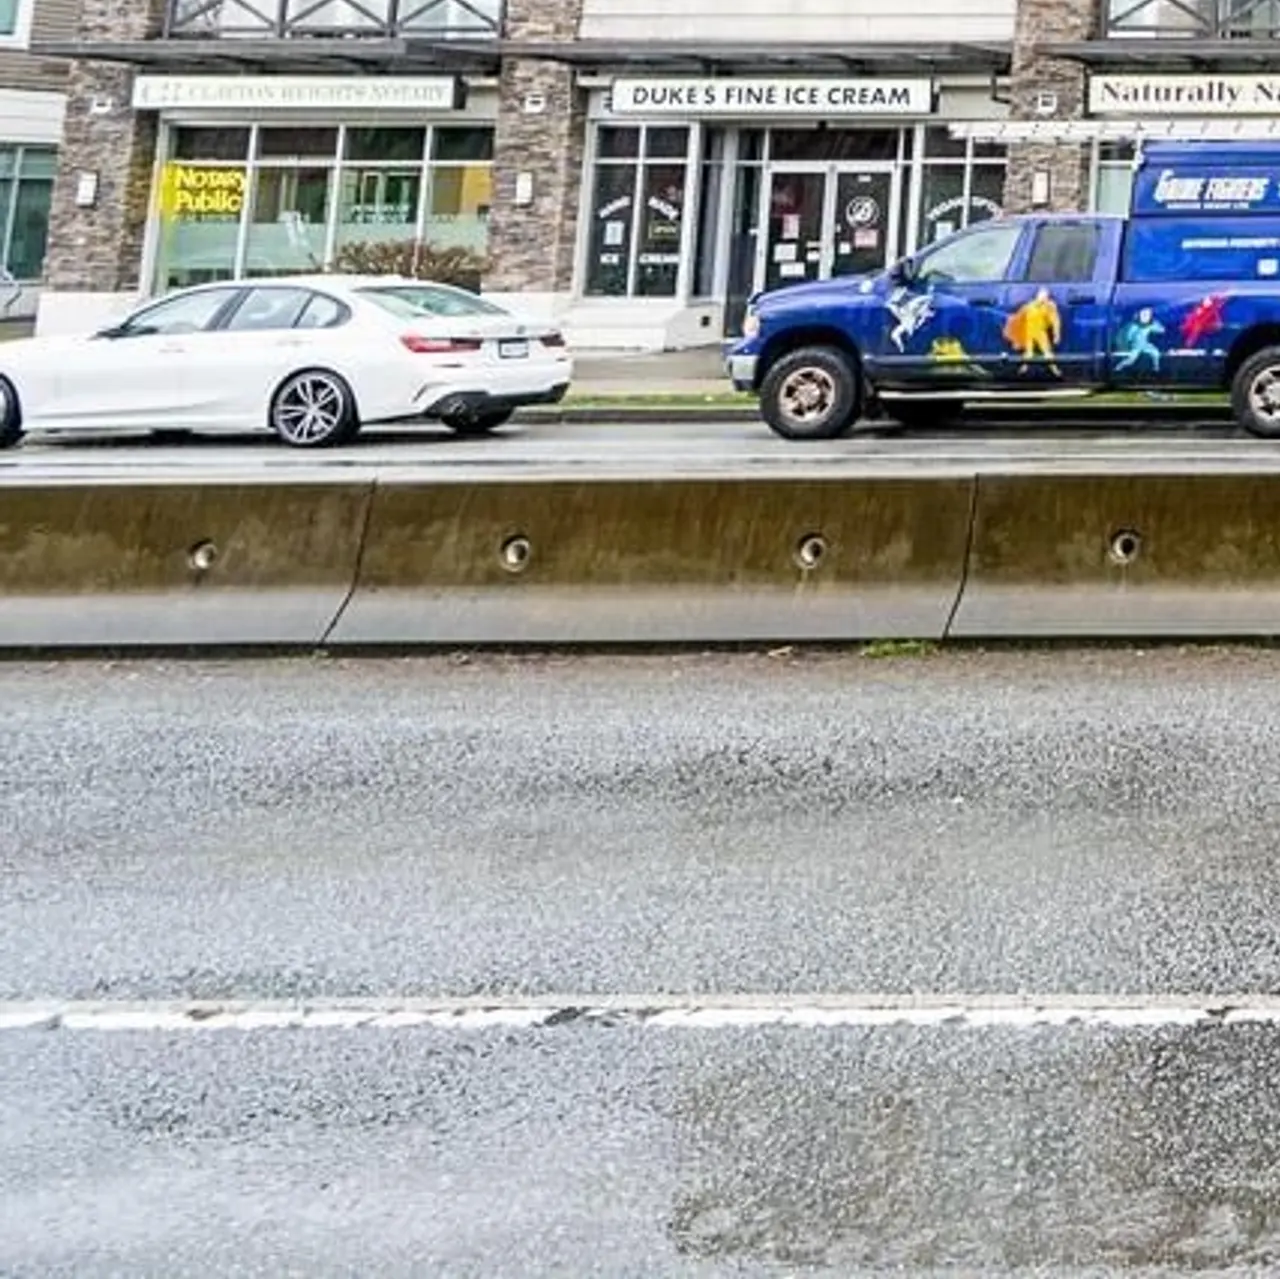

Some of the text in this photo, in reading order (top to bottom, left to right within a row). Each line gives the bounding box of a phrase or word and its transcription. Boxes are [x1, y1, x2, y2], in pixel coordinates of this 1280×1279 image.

[632, 86, 911, 105] DUKES FINE ICE CREAM
[1101, 81, 1243, 107] Naturally
[173, 189, 242, 213] Public
